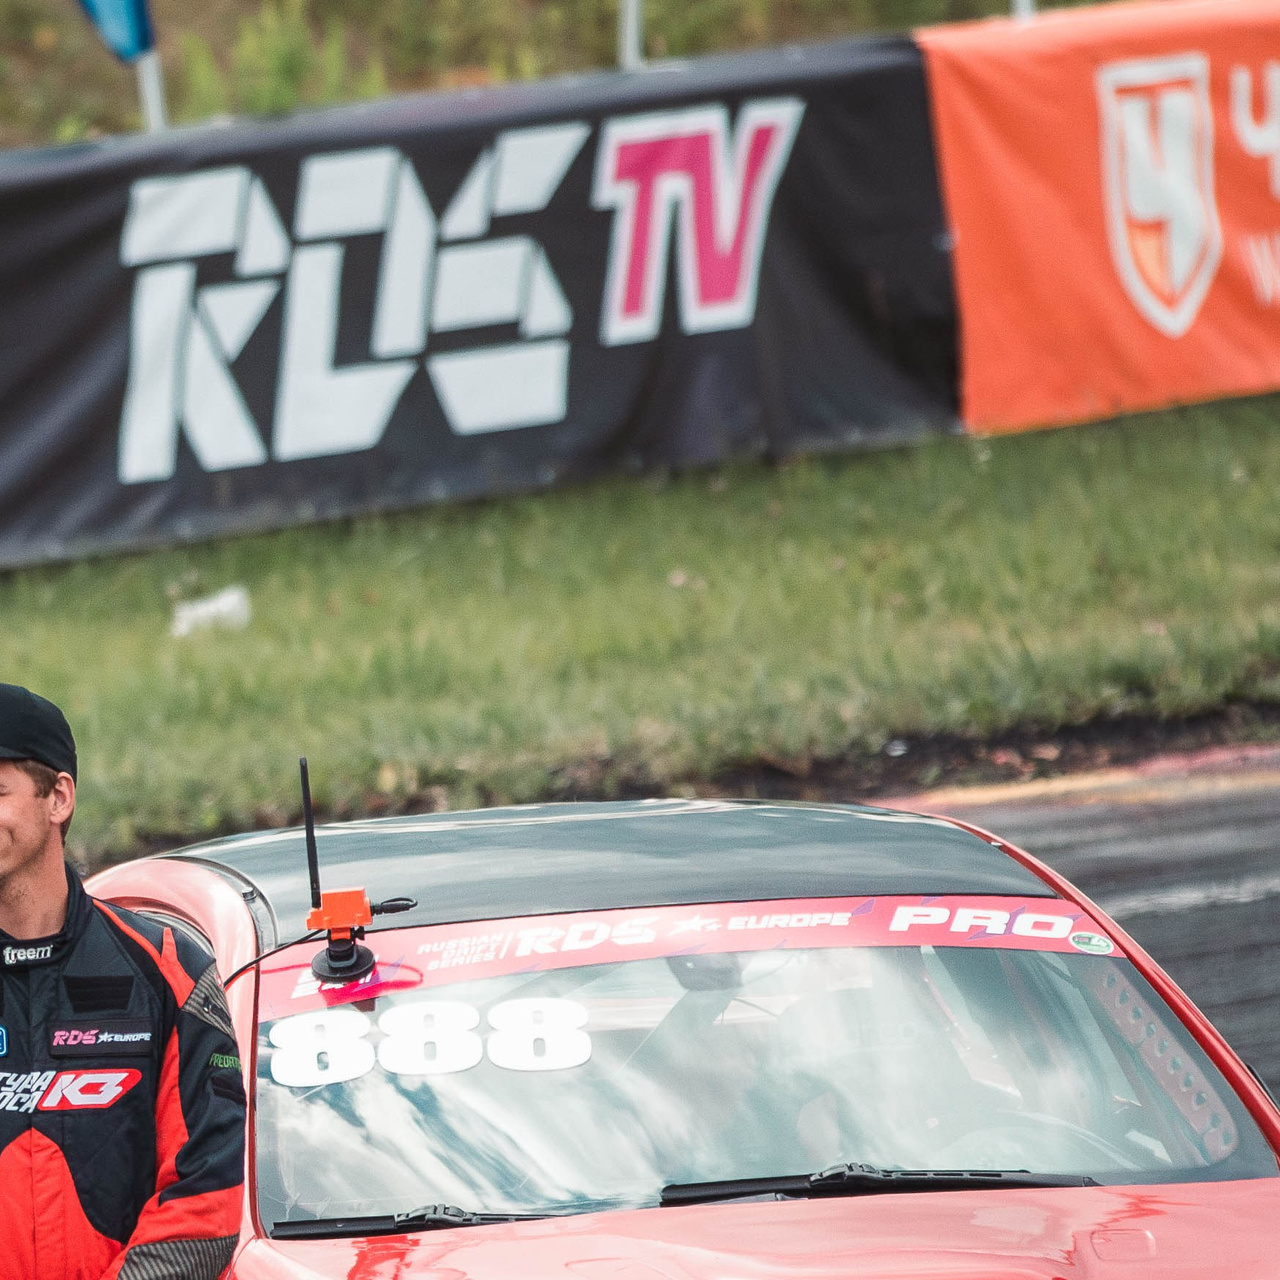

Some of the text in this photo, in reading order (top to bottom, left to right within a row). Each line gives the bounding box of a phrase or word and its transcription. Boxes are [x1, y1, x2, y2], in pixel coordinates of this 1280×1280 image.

[118, 121, 592, 486] RDS
[515, 912, 852, 958] RDS EUROPE
[889, 906, 1074, 938] PRO
[416, 932, 504, 955] RUSSIAN
[426, 952, 496, 971] SERIES
[114, 1032, 152, 1042] EUROPE
[269, 997, 592, 1088] 888
